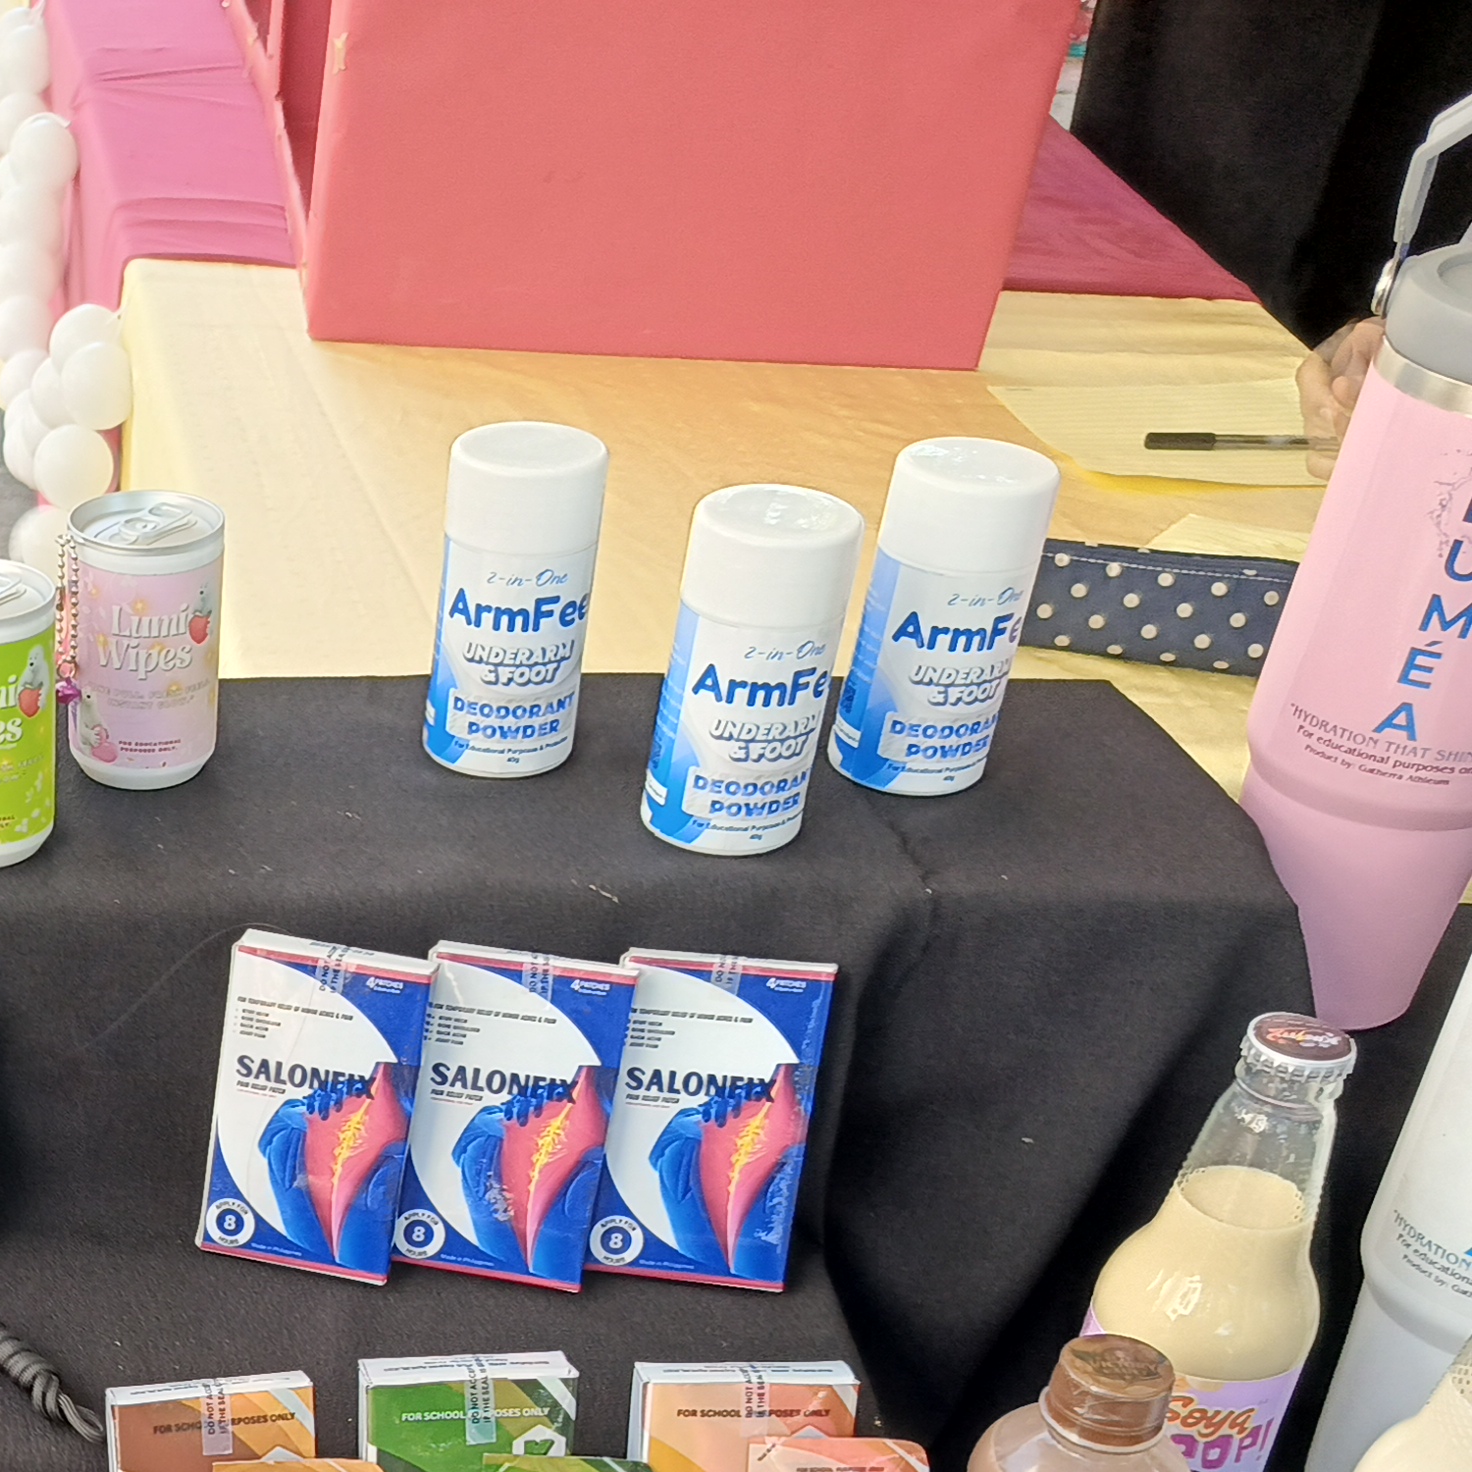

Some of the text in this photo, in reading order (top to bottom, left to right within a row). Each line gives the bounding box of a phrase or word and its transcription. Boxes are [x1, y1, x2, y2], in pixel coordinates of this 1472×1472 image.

[112, 603, 189, 639] Lumi
[98, 638, 193, 681] Wipes
[463, 640, 575, 665] UNDERARM
[501, 664, 560, 687] FOOT
[950, 681, 1002, 705] FOOT
[453, 692, 575, 720] DEODORANT
[467, 718, 560, 740] POWDER
[750, 739, 808, 762] FOOT
[1316, 735, 1390, 766] educational
[1395, 759, 1456, 775] purposes
[1385, 741, 1431, 760] THAT
[710, 792, 801, 817] POWDER
[222, 1215, 236, 1230] 8
[412, 1226, 425, 1242] 8
[608, 1232, 623, 1248] 8
[153, 1412, 296, 1434] FOR ONLY
[402, 1407, 550, 1421] FOR SCHOOL ONLY
[677, 1409, 741, 1418] FOR SCHOOL
